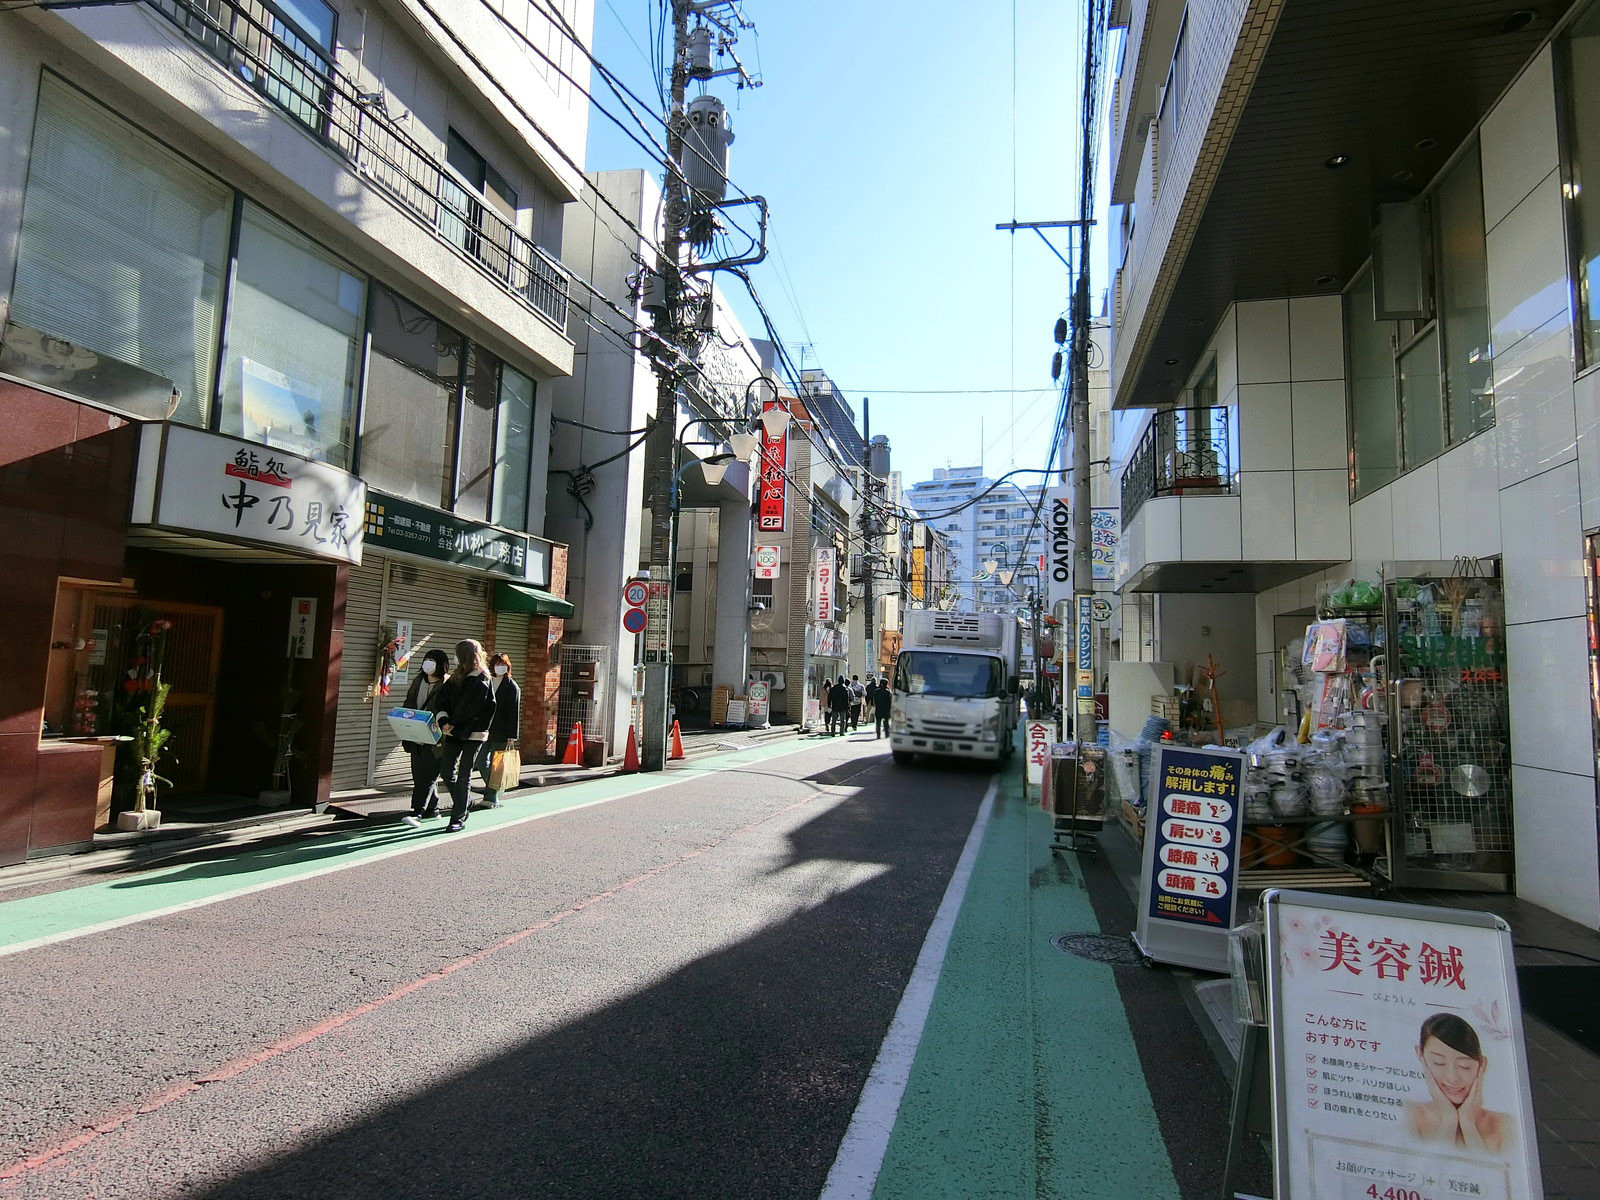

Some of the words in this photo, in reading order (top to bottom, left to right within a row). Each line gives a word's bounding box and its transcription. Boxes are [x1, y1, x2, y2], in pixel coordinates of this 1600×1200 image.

[233, 448, 288, 481] 鮨処
[222, 480, 350, 549] 中乃見家
[763, 518, 781, 527] 2F
[438, 525, 454, 538] 株式
[1052, 498, 1069, 582] KOKUYO
[437, 537, 453, 551] 会社
[455, 530, 524, 567] 小松工務店
[1092, 548, 1116, 563] のど
[630, 588, 644, 600] 20
[818, 568, 830, 620] クリーニング
[1167, 764, 1234, 781] その身体の痛み
[1165, 775, 1236, 796] 解消します!
[1171, 799, 1201, 816] 腰痛
[1169, 823, 1204, 839] 肩こり
[1167, 848, 1198, 866] 膝痛
[1165, 873, 1196, 891] 頭痛
[1318, 929, 1467, 990] 美容鍼
[1305, 1012, 1367, 1031] こんな方に
[1306, 1030, 1381, 1052] おすすめです
[1321, 1056, 1426, 1079] お顔周りをシャープにしたい
[1322, 1071, 1411, 1093] 肌にツヤ・ハリがほしい
[1323, 1087, 1404, 1107] ほうれい線が気になる
[1324, 1102, 1397, 1121] 目の疲れをとりたい
[1335, 1160, 1416, 1182] お顔のマッサージ
[1366, 1183, 1421, 1200] 4,400
